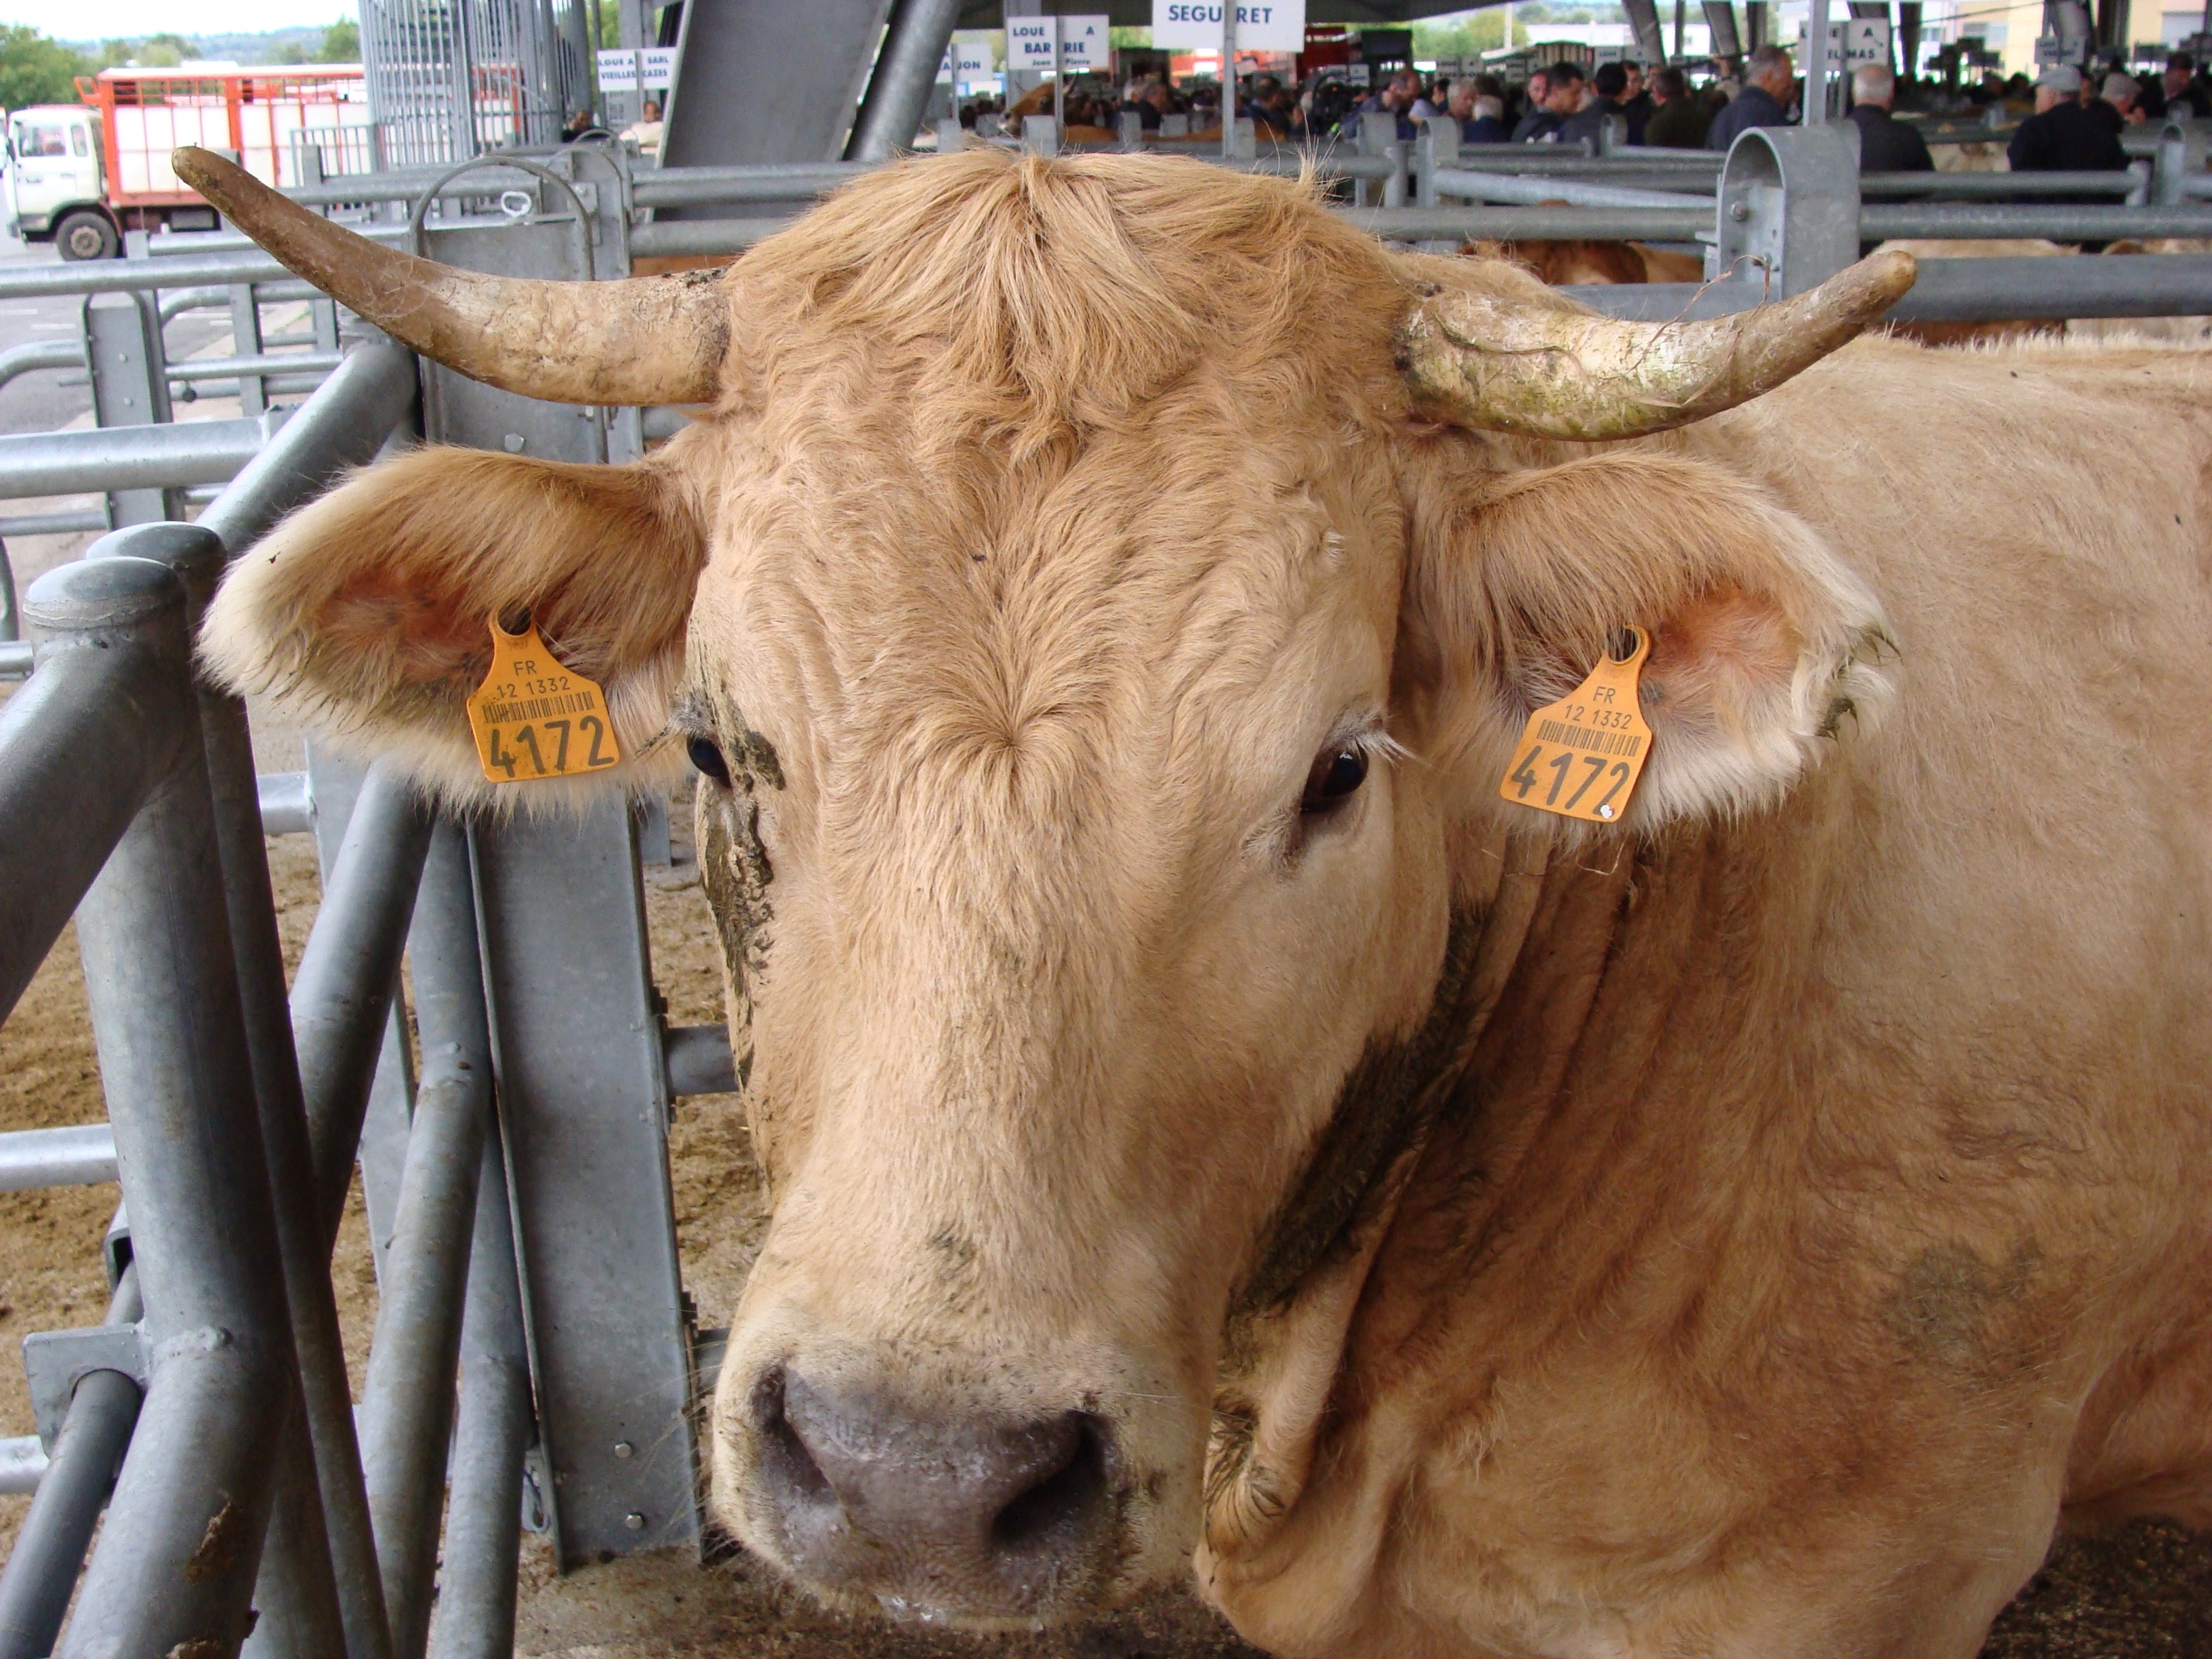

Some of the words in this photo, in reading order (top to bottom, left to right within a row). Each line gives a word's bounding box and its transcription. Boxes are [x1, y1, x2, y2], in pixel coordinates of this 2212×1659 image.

[1012, 26, 1044, 36] LOUE
[513, 661, 537, 676] FR
[496, 683, 517, 699] 12
[525, 676, 571, 695] 1332
[1593, 687, 1616, 704] FR
[1565, 704, 1584, 722] 12
[1592, 711, 1632, 730] 1332
[490, 715, 615, 778] 4172
[1511, 745, 1631, 817] 4172
